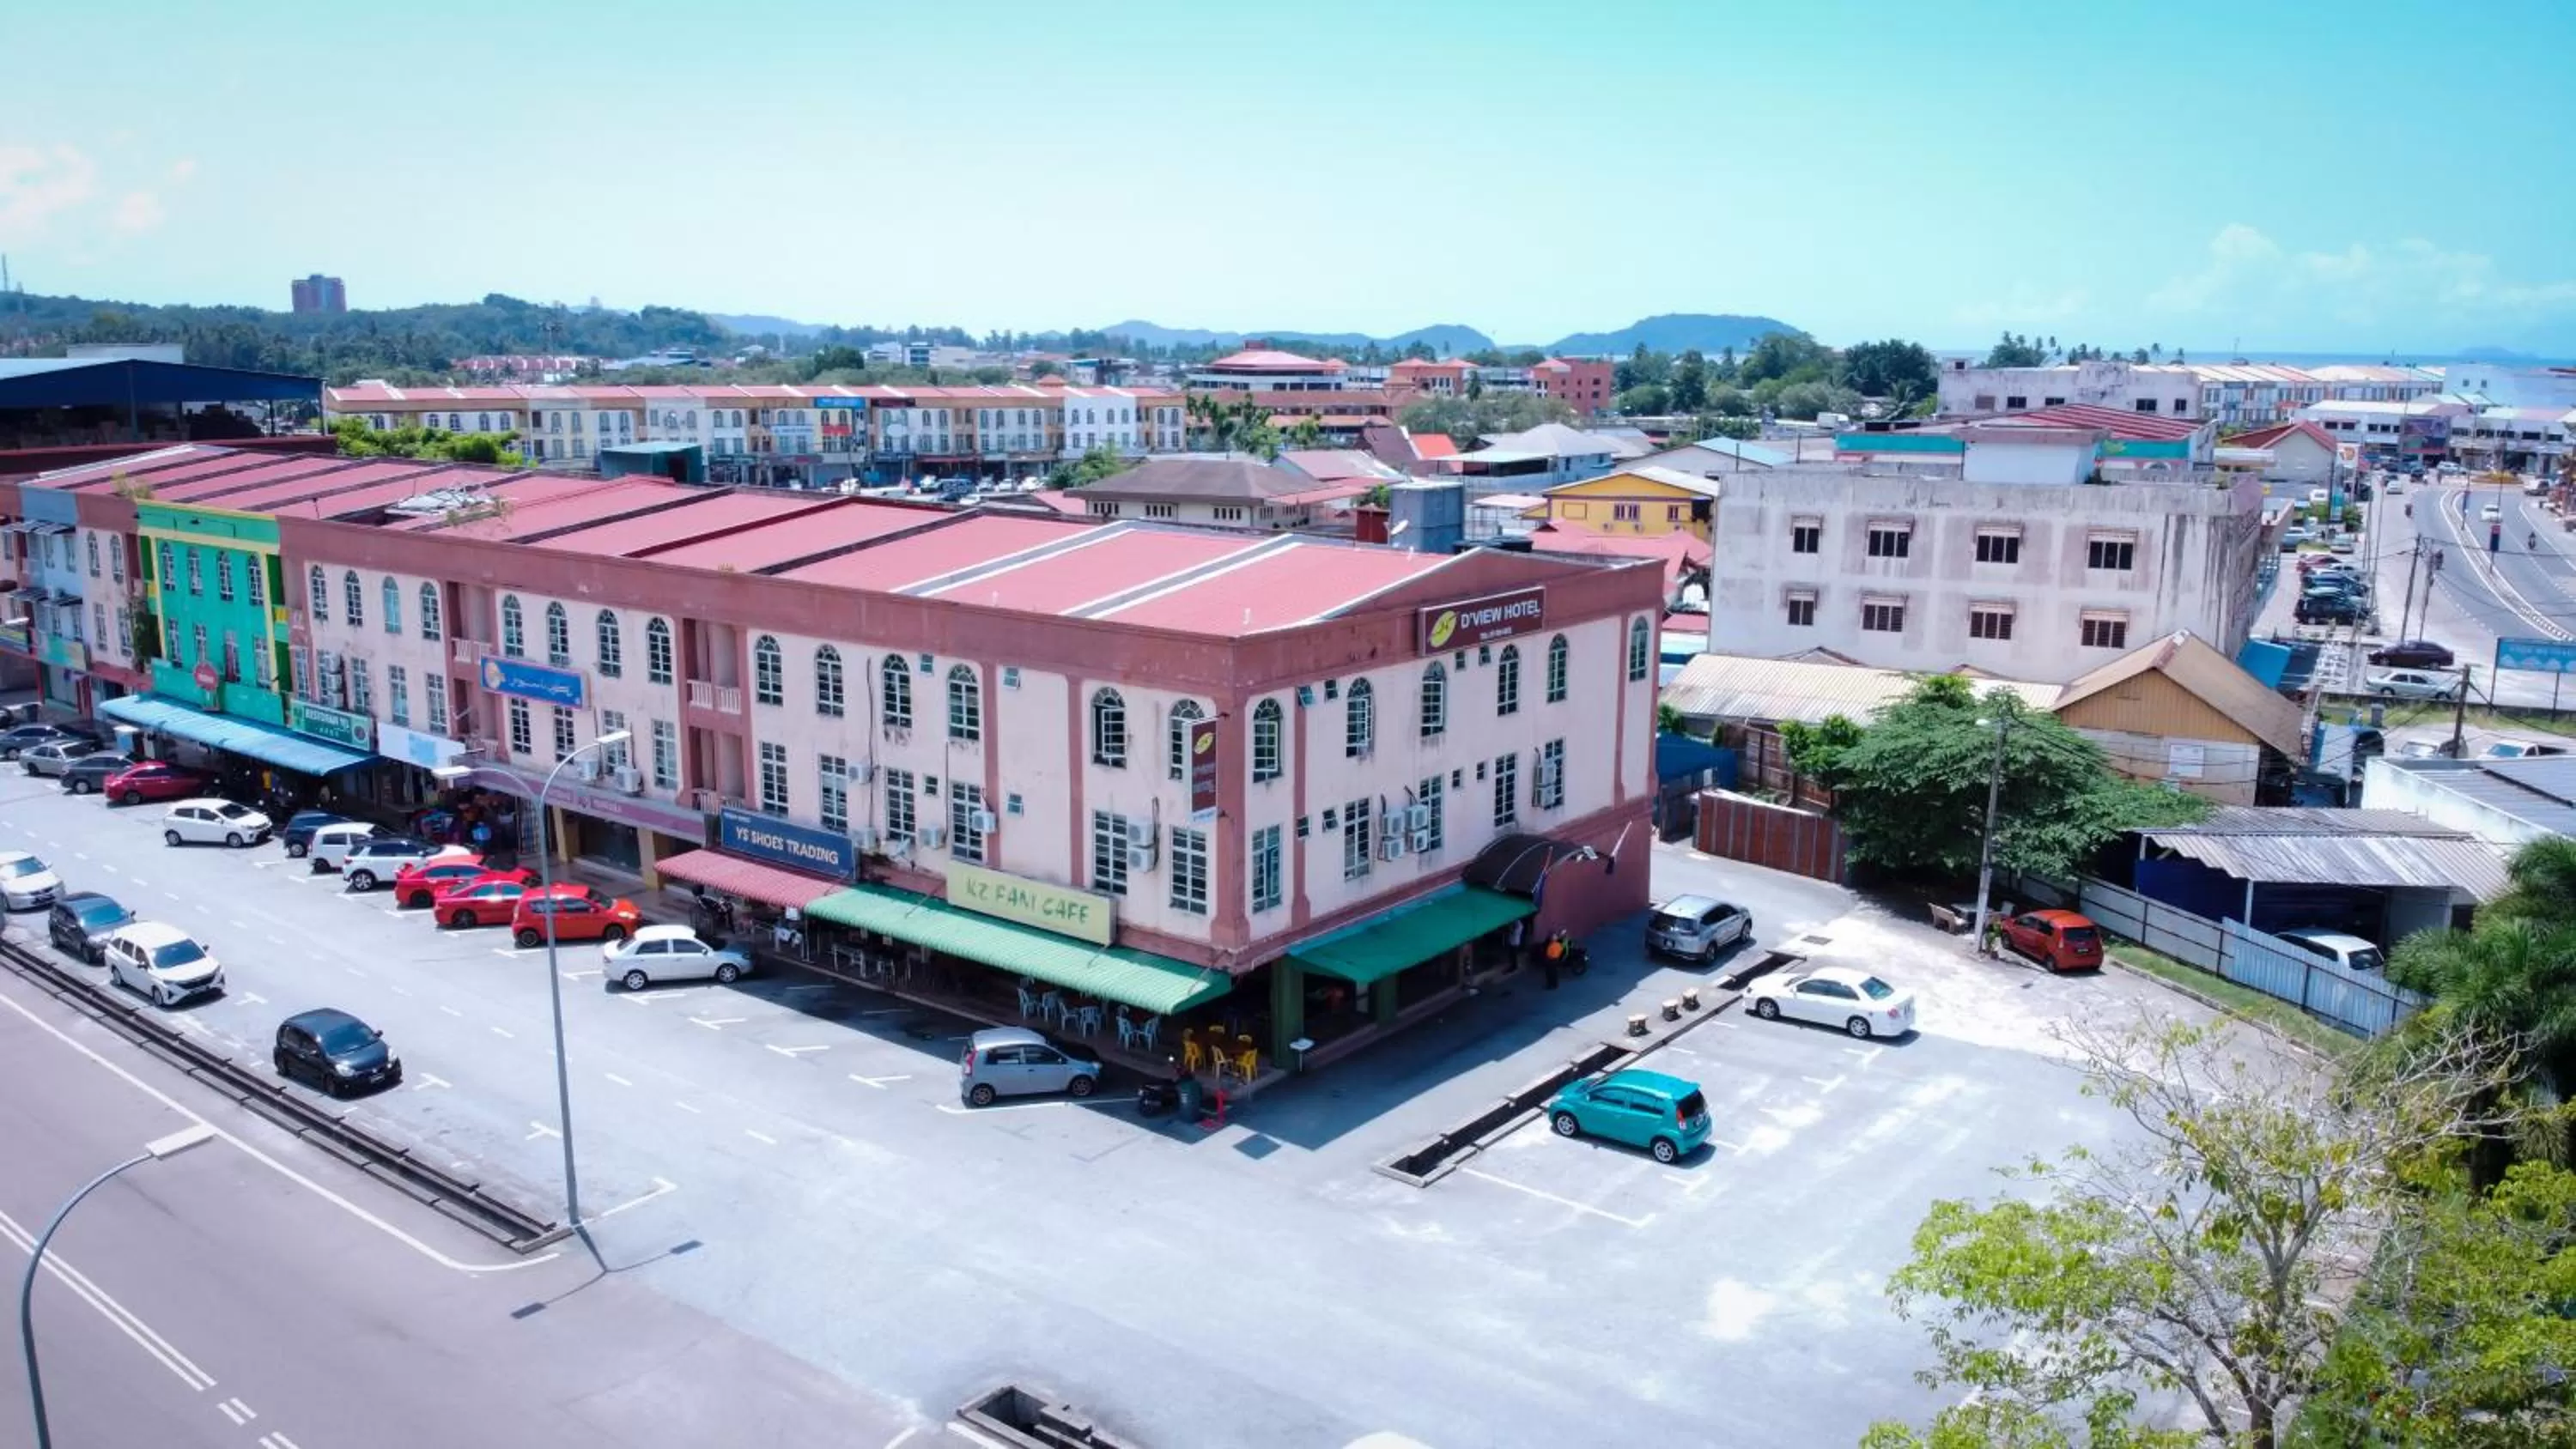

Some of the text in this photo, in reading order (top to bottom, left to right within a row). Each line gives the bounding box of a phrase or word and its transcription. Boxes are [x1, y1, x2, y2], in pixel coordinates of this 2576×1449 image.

[1461, 599, 1540, 629] D'VIEW HOTEL
[736, 826, 839, 865] YS SHOES TRADING
[1042, 897, 1090, 925] CAFE
